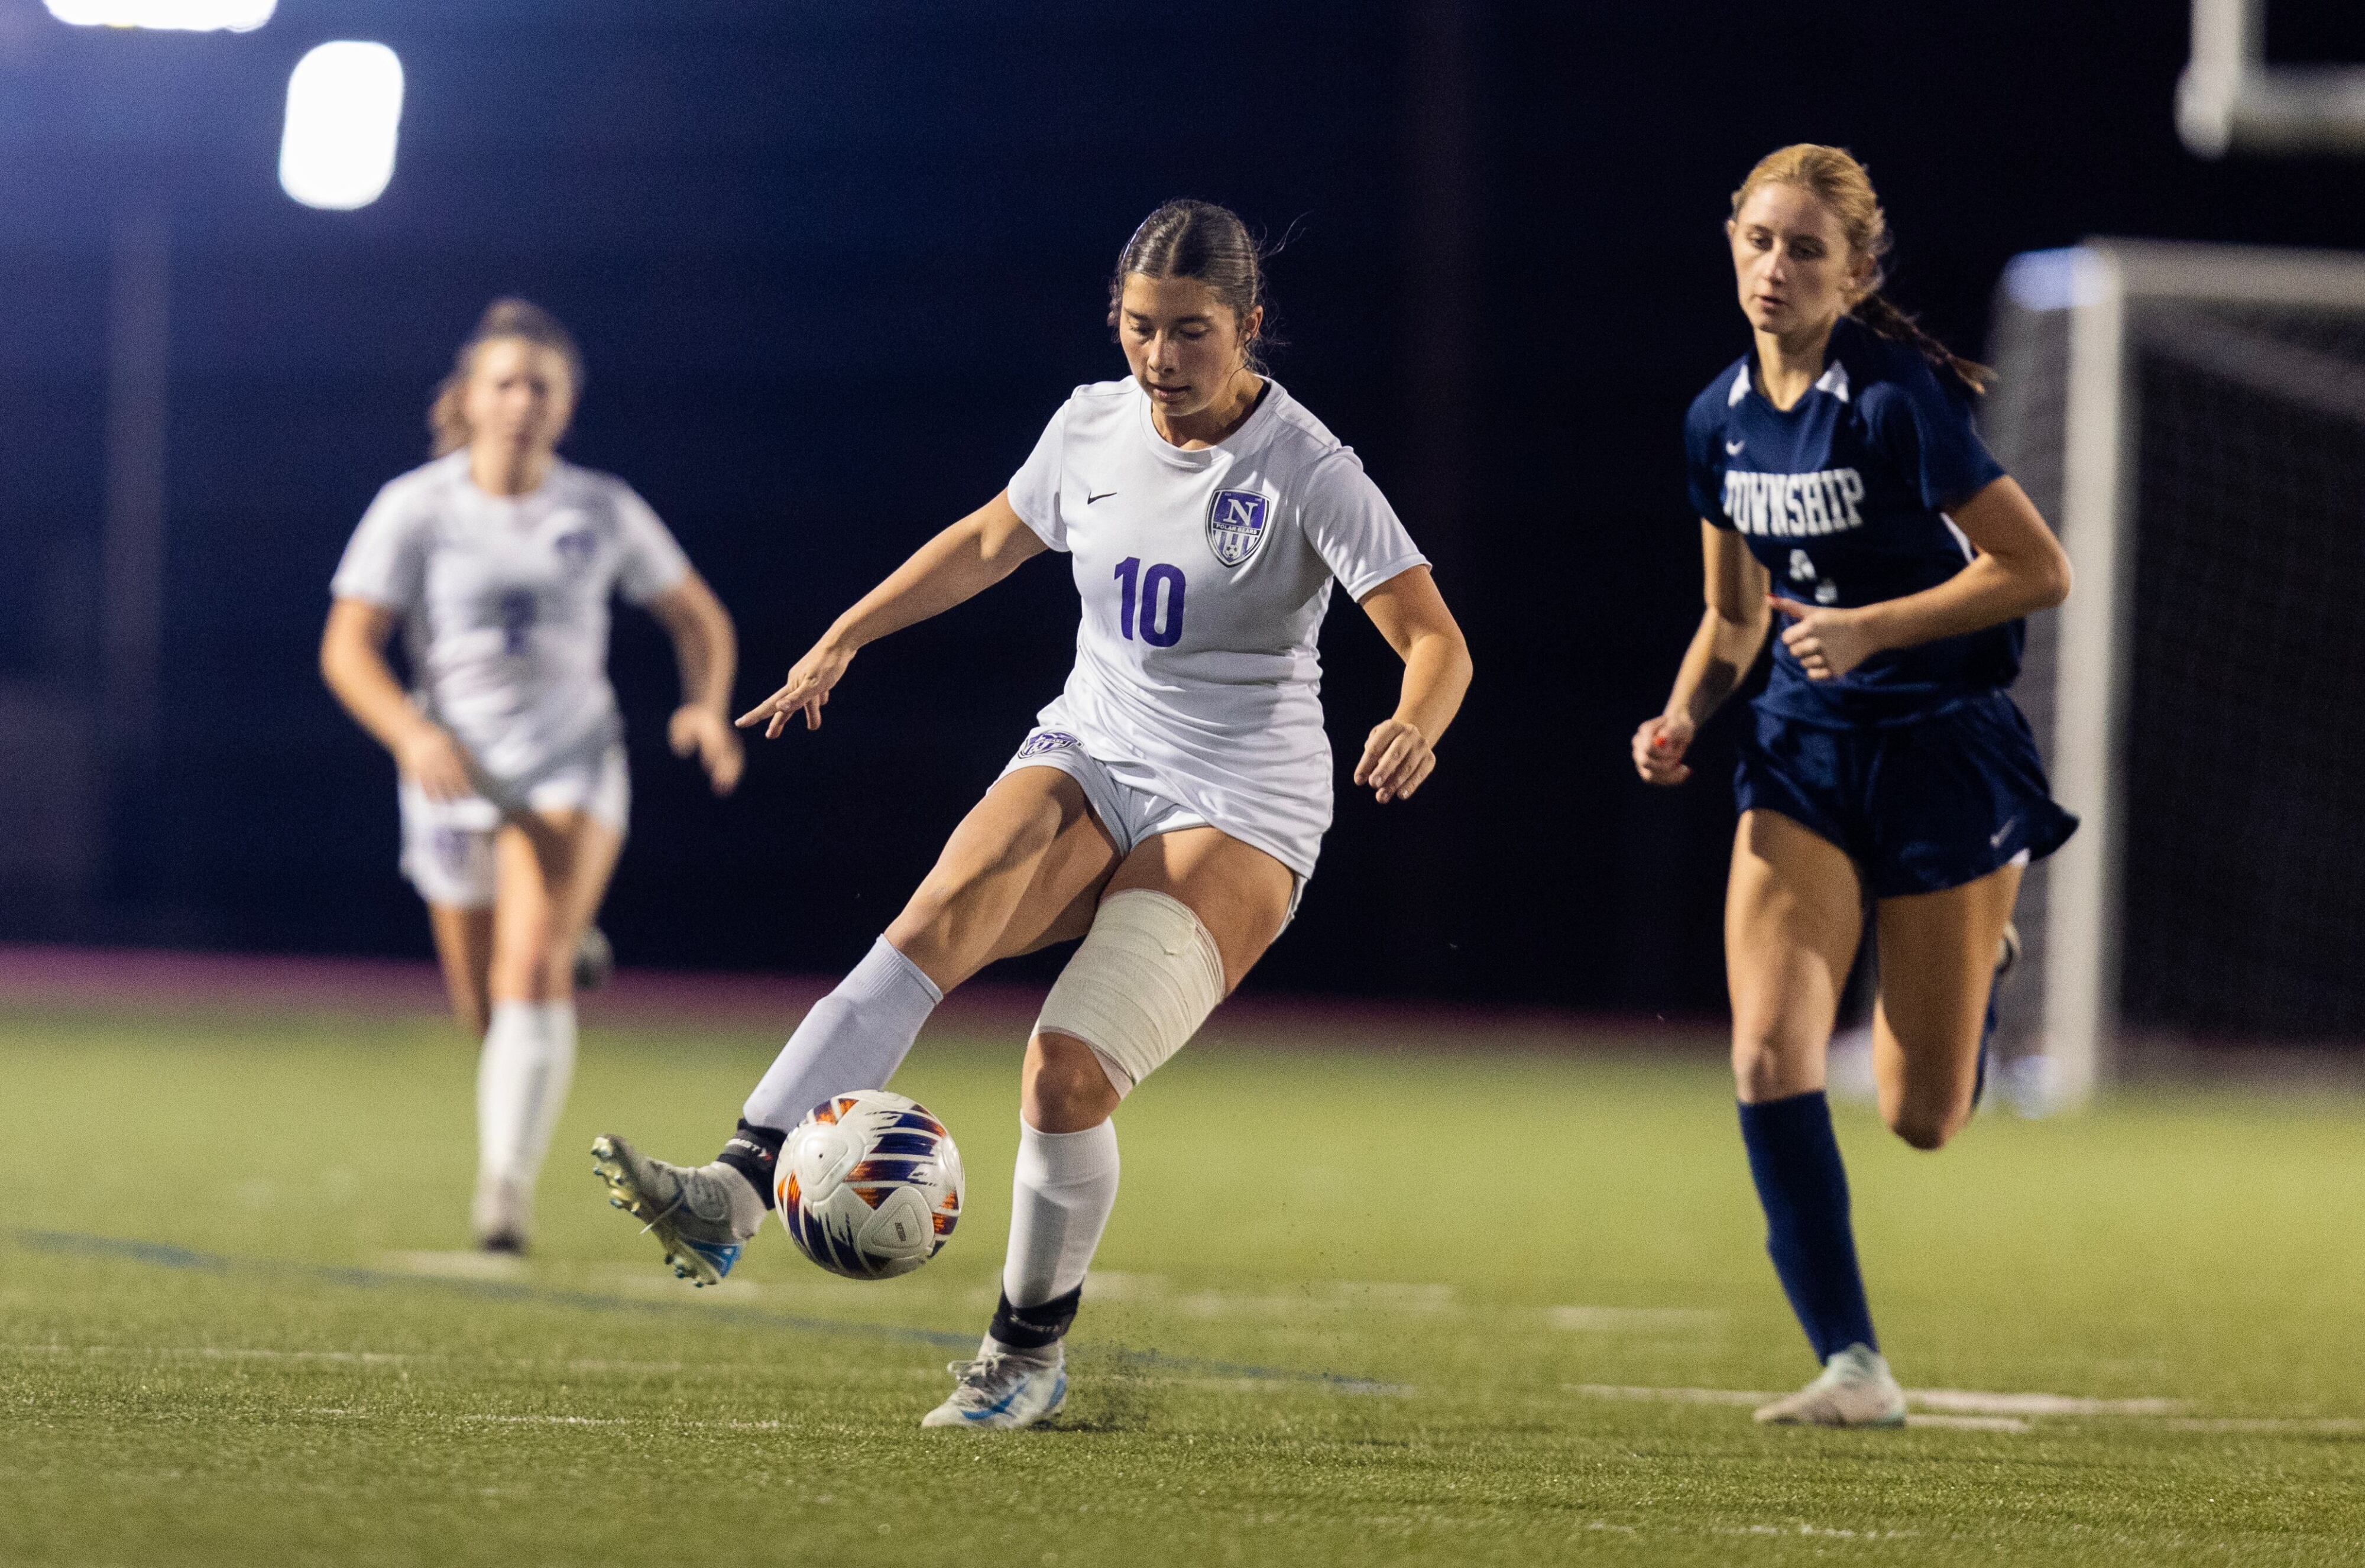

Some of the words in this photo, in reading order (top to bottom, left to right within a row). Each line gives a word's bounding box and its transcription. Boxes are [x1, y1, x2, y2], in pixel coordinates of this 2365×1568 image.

[1223, 498, 1258, 526] N
[1723, 468, 1864, 536] TOWNSHIP
[1114, 556, 1186, 647] 10
